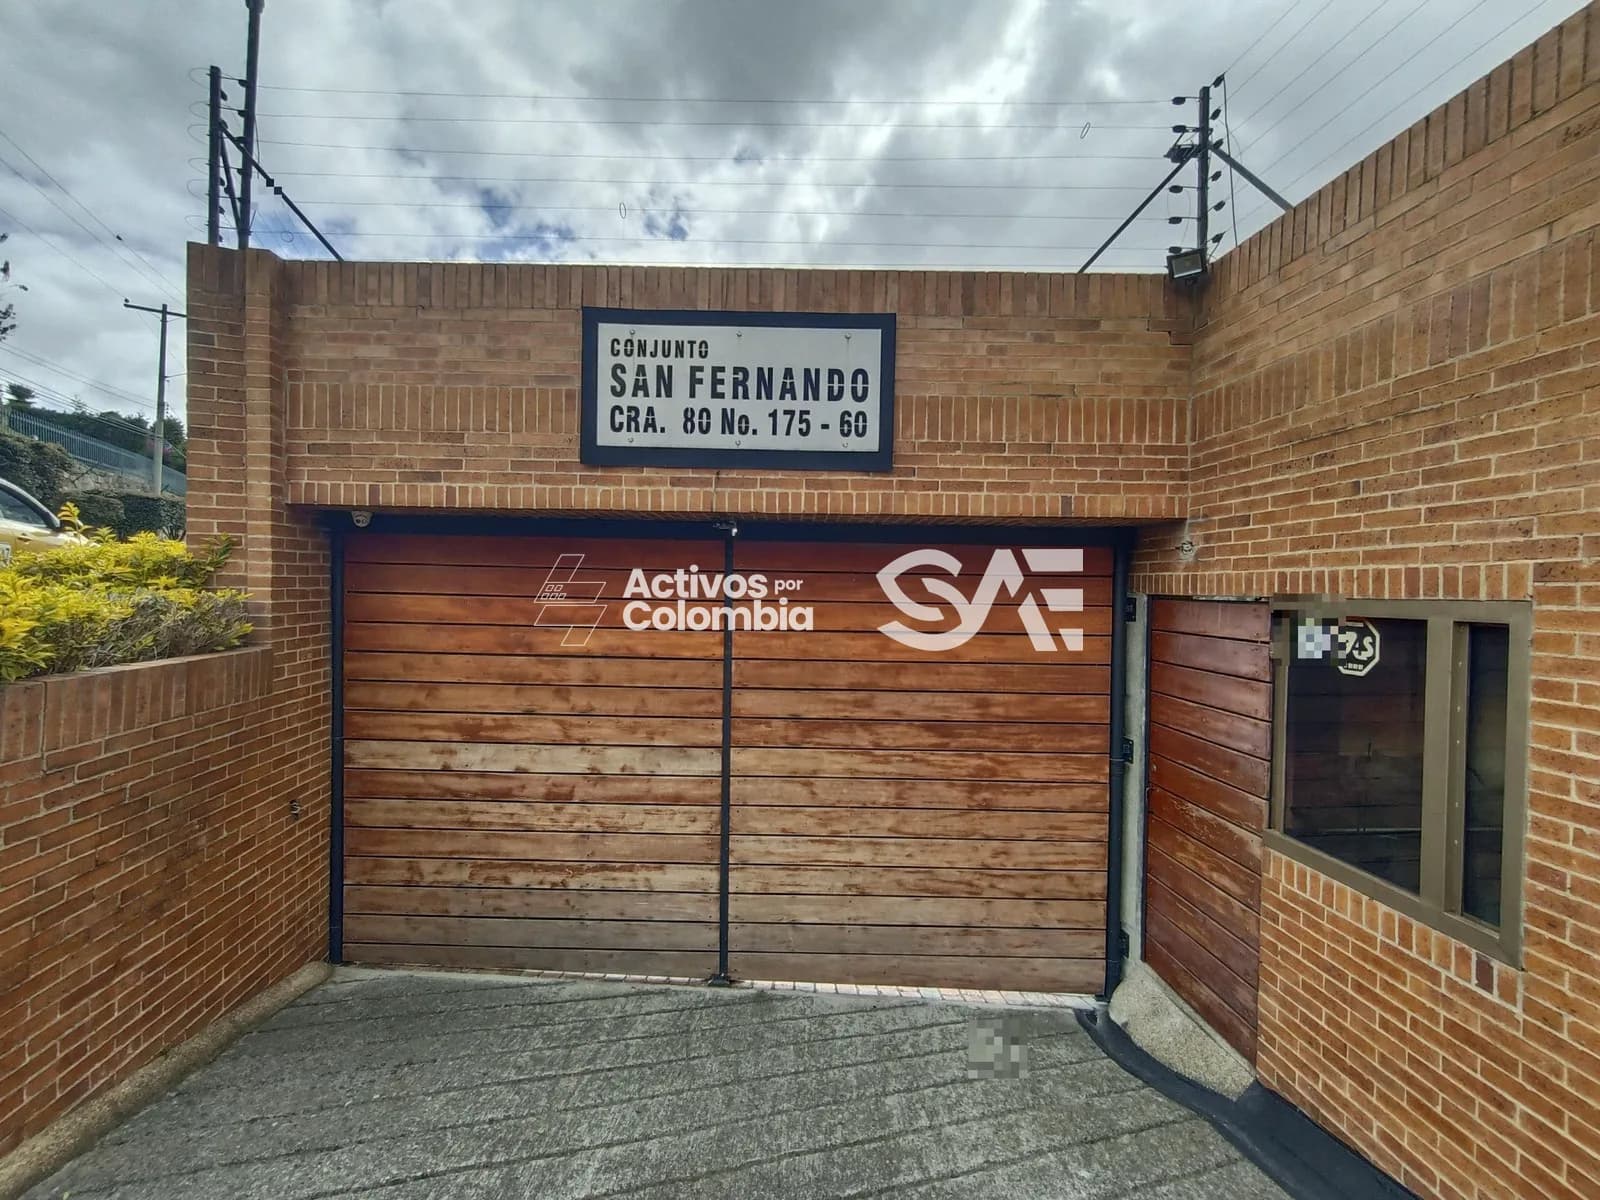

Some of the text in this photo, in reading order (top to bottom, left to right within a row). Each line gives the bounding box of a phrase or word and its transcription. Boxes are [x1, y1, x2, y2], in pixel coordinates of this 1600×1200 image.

[610, 337, 708, 359] CONJUNTO
[610, 363, 869, 402] SAN FERNANDO
[609, 405, 666, 433] CRA.
[682, 407, 711, 435] 80
[721, 408, 758, 435] No.
[768, 409, 811, 437] 175
[839, 410, 867, 438] 60
